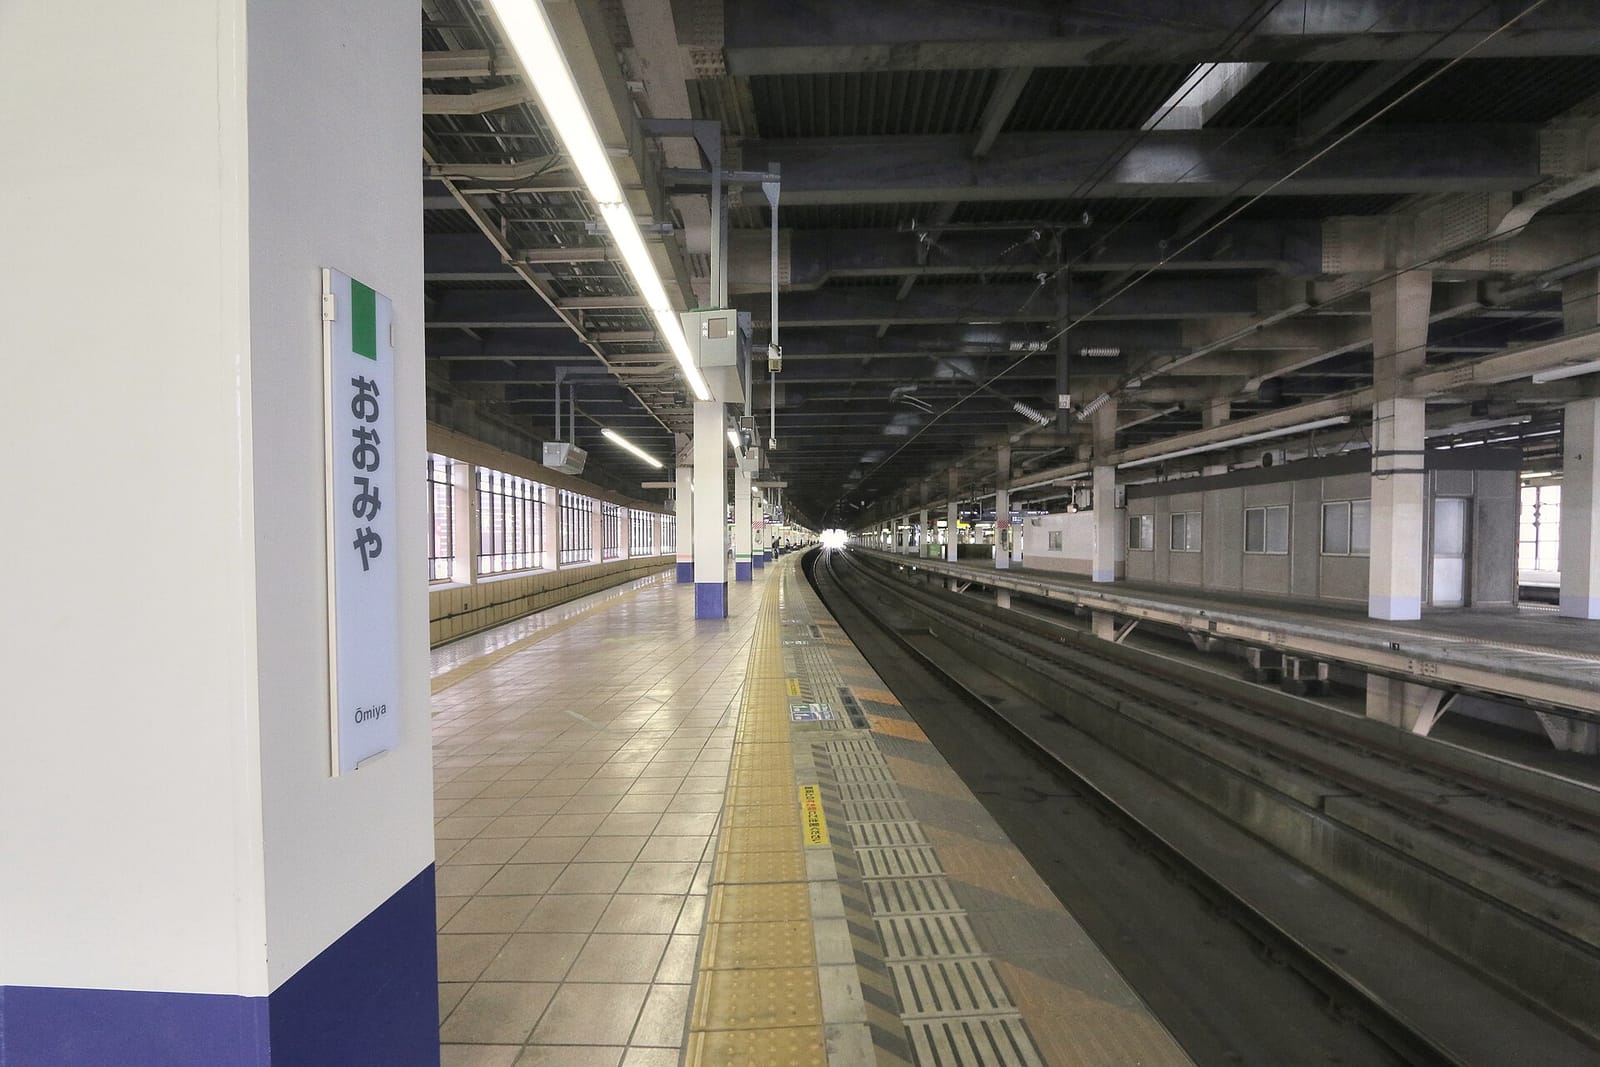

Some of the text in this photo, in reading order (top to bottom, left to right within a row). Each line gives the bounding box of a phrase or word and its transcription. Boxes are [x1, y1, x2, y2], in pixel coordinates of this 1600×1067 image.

[351, 375, 382, 572] おおみや
[355, 704, 387, 724] Ōmiya
